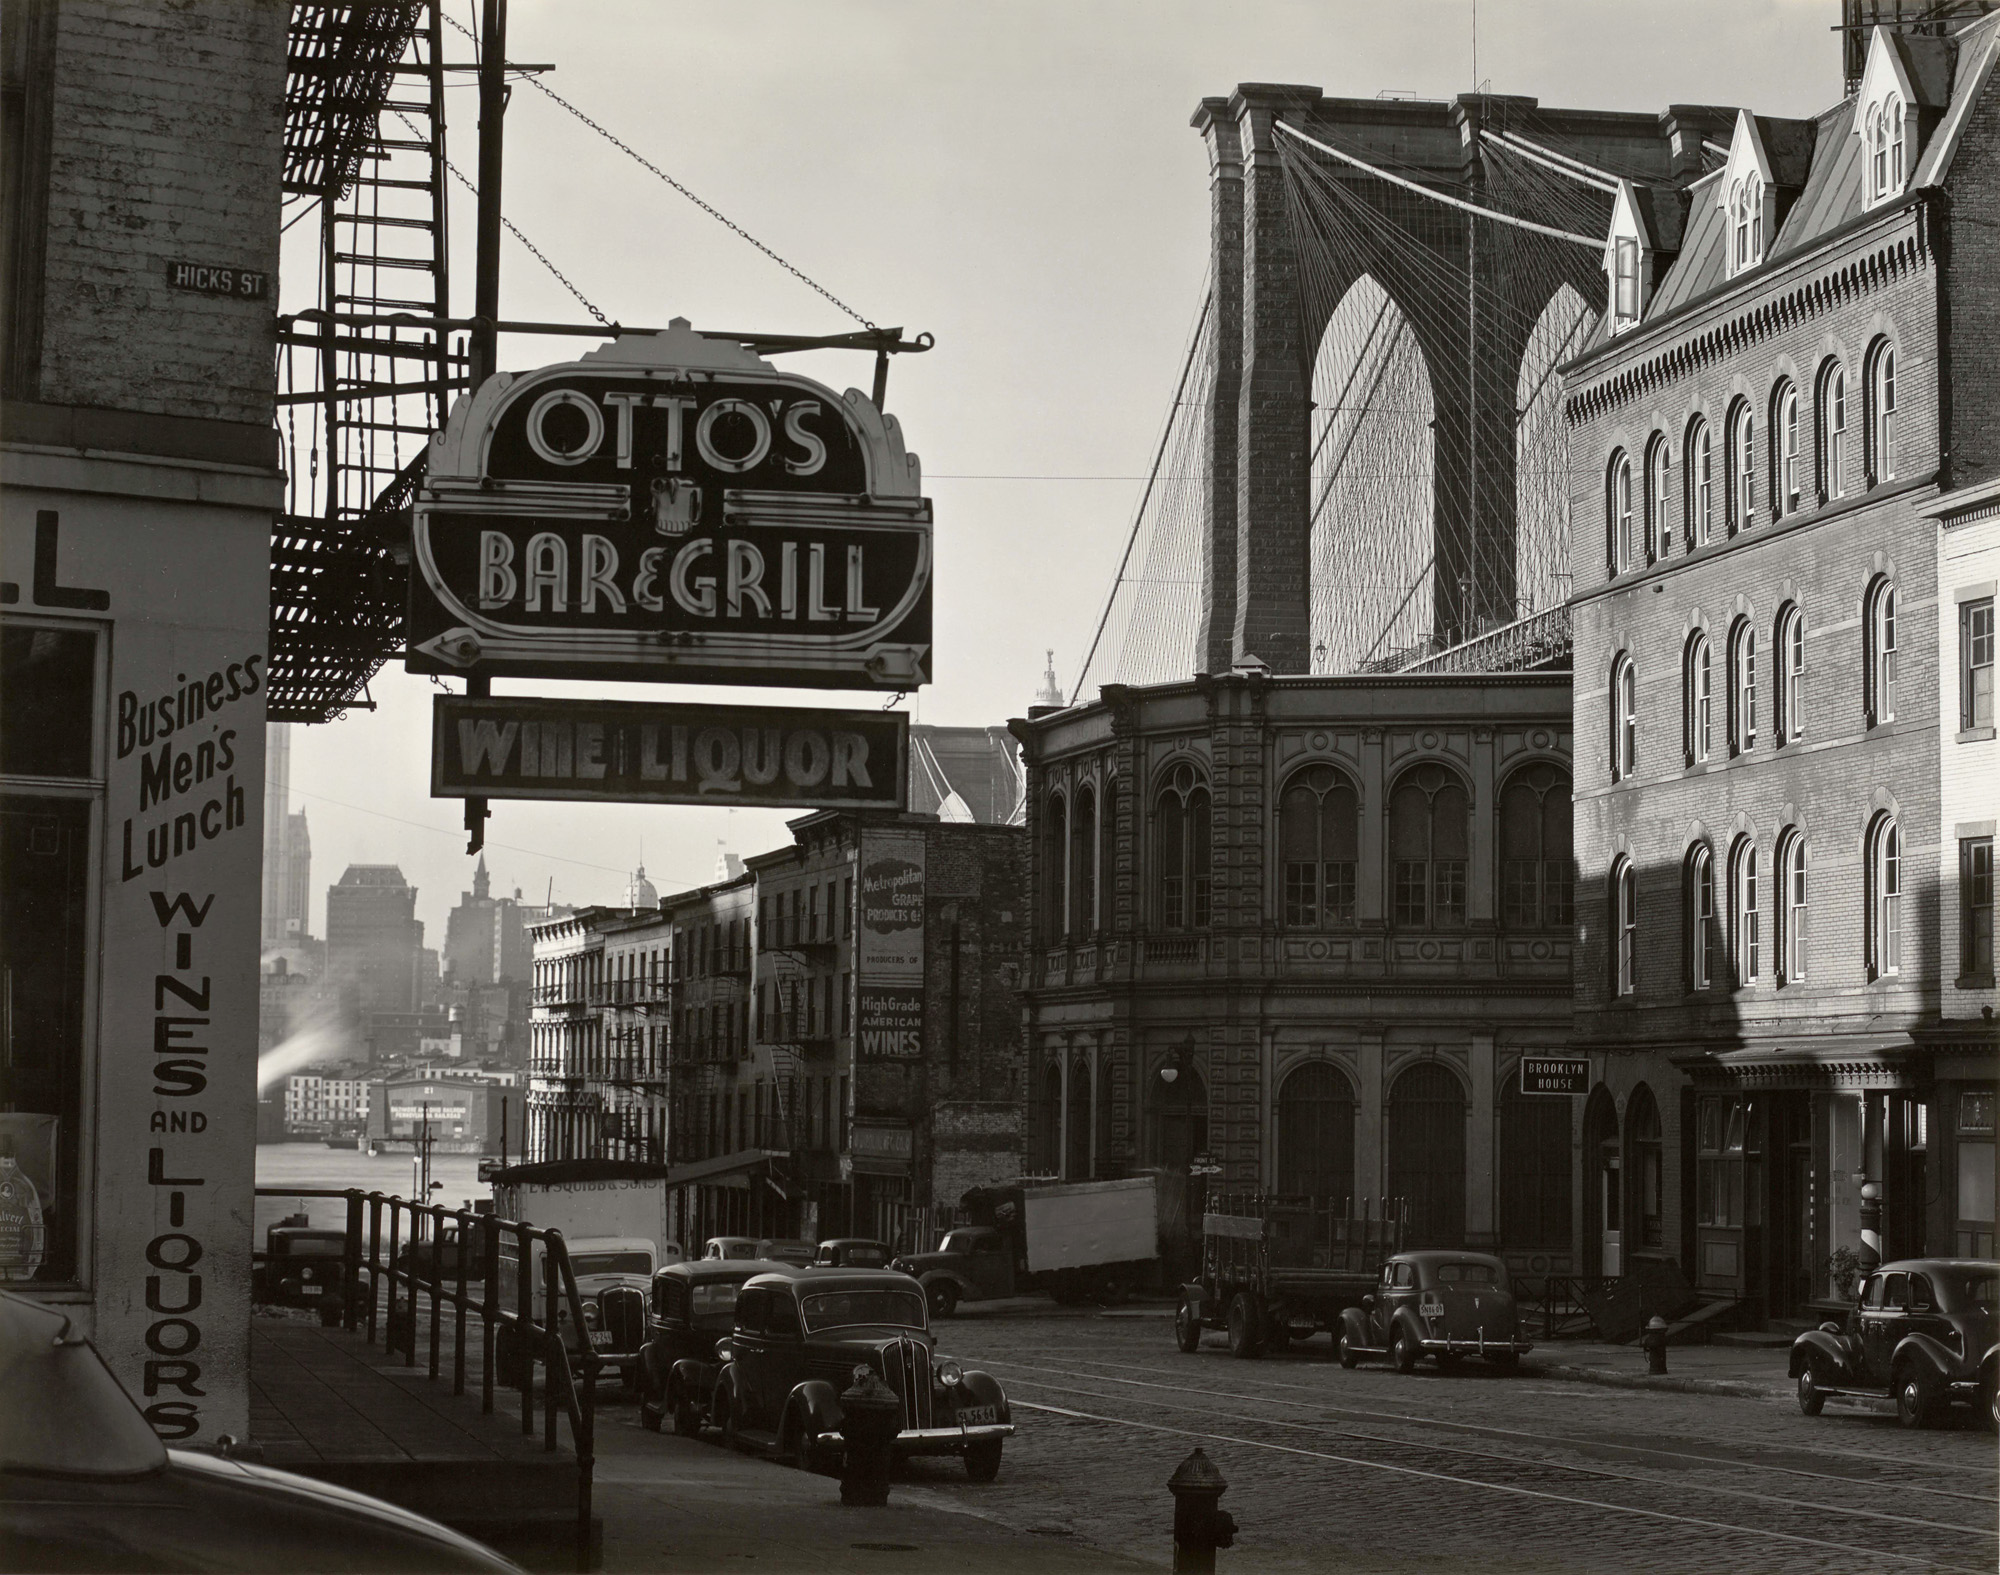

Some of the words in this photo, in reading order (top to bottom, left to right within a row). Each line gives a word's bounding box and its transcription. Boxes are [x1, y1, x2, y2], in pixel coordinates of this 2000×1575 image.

[177, 265, 232, 292] HICKS
[241, 273, 263, 294] ST
[526, 389, 828, 476] OTTO'S
[117, 654, 262, 760] Business
[139, 724, 237, 812] Men's
[457, 719, 607, 779] WINE
[640, 724, 873, 792] LIQUOR
[122, 774, 244, 882] Lunch
[863, 867, 923, 893] Metropolitan
[892, 894, 923, 907] GRAPE
[867, 909, 907, 922] PRODUCTS
[867, 956, 905, 964] PRODUCERS
[909, 956, 918, 964] OF
[149, 891, 215, 1097] WINES
[862, 1017, 922, 1027] AMERICAN
[862, 1031, 921, 1055] WINES
[1528, 1063, 1584, 1075] BROOKLYN
[1538, 1078, 1573, 1089] HOUSE
[150, 1111, 207, 1134] AND
[143, 1148, 207, 1440] LIQUORS
